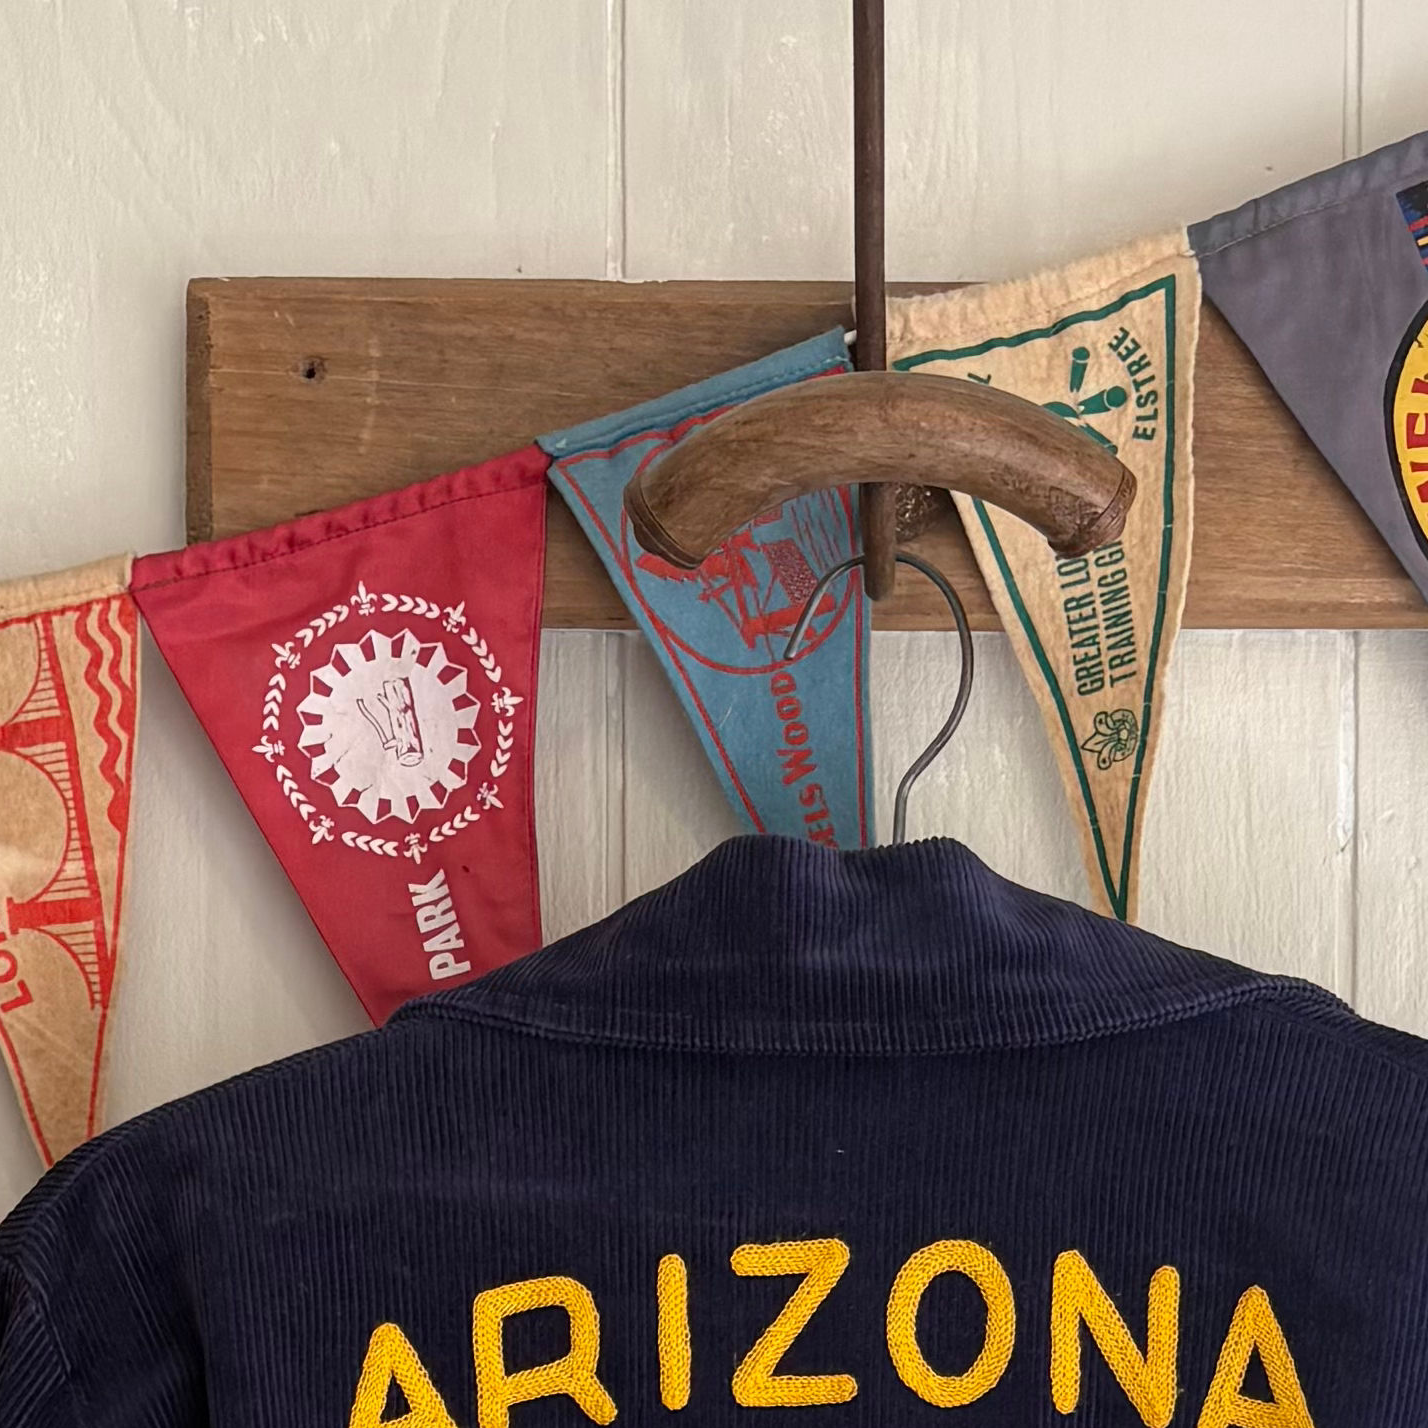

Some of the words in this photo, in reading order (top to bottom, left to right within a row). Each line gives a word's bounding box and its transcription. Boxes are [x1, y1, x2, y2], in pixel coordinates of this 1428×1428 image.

[1106, 326, 1159, 442] ELSTREE
[1063, 591, 1105, 696] GREATER
[1097, 568, 1137, 688] TRAINING
[799, 783, 839, 849] ELS
[408, 867, 471, 981] PARK
